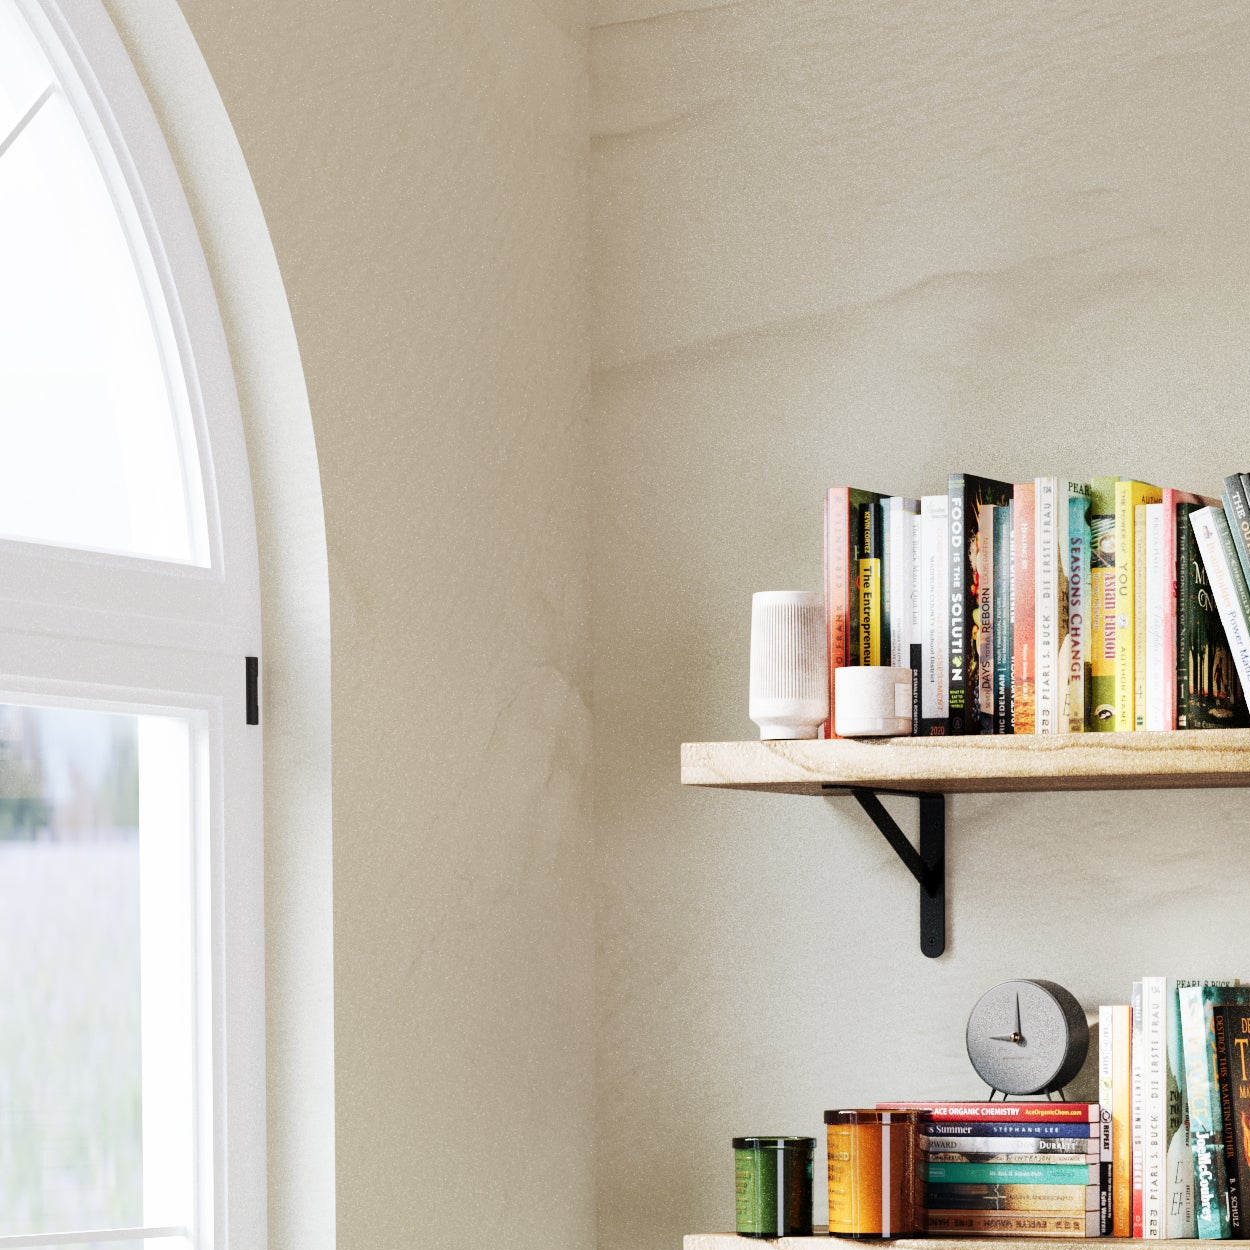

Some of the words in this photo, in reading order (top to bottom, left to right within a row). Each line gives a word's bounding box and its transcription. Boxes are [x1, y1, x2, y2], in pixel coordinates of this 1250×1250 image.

[864, 511, 872, 530] KEVIN
[1041, 502, 1051, 534] FRAU
[1232, 491, 1246, 519] THE
[951, 497, 963, 548] FOOD
[864, 530, 872, 553] CORTEZ
[951, 552, 963, 563] IS
[861, 565, 873, 588] The
[951, 566, 963, 587] THE
[1069, 536, 1083, 607] SEASONS
[1119, 562, 1129, 596] YOU
[981, 587, 992, 634] REBORN
[1041, 614, 1051, 647] BUCK
[1228, 611, 1244, 646] Power
[1069, 613, 1083, 683] CHANGE
[981, 660, 992, 690] DAYS
[1041, 664, 1051, 701] PEARL
[998, 674, 1006, 717] EDELMAN
[929, 725, 945, 736] 2020
[1215, 1015, 1226, 1055] DESTROY
[1218, 1057, 1228, 1078] THIS
[934, 1108, 947, 1117] ACE
[948, 1107, 979, 1117] ORGANIC
[980, 1107, 1020, 1117] CHEMISTRY
[1025, 1108, 1083, 1117] AceOrganicChem.com
[1220, 1083, 1231, 1121] MARTIN
[936, 1125, 972, 1135] Summer
[993, 1126, 1042, 1134] STEPHANIE
[1044, 1126, 1060, 1134] LEE
[1038, 1140, 1078, 1150] DURRETT
[1150, 1115, 1159, 1147] BUCK
[1223, 1122, 1235, 1159] LUTHER
[1150, 1164, 1159, 1201] PEARL
[1231, 1195, 1240, 1228] SCHULZ
